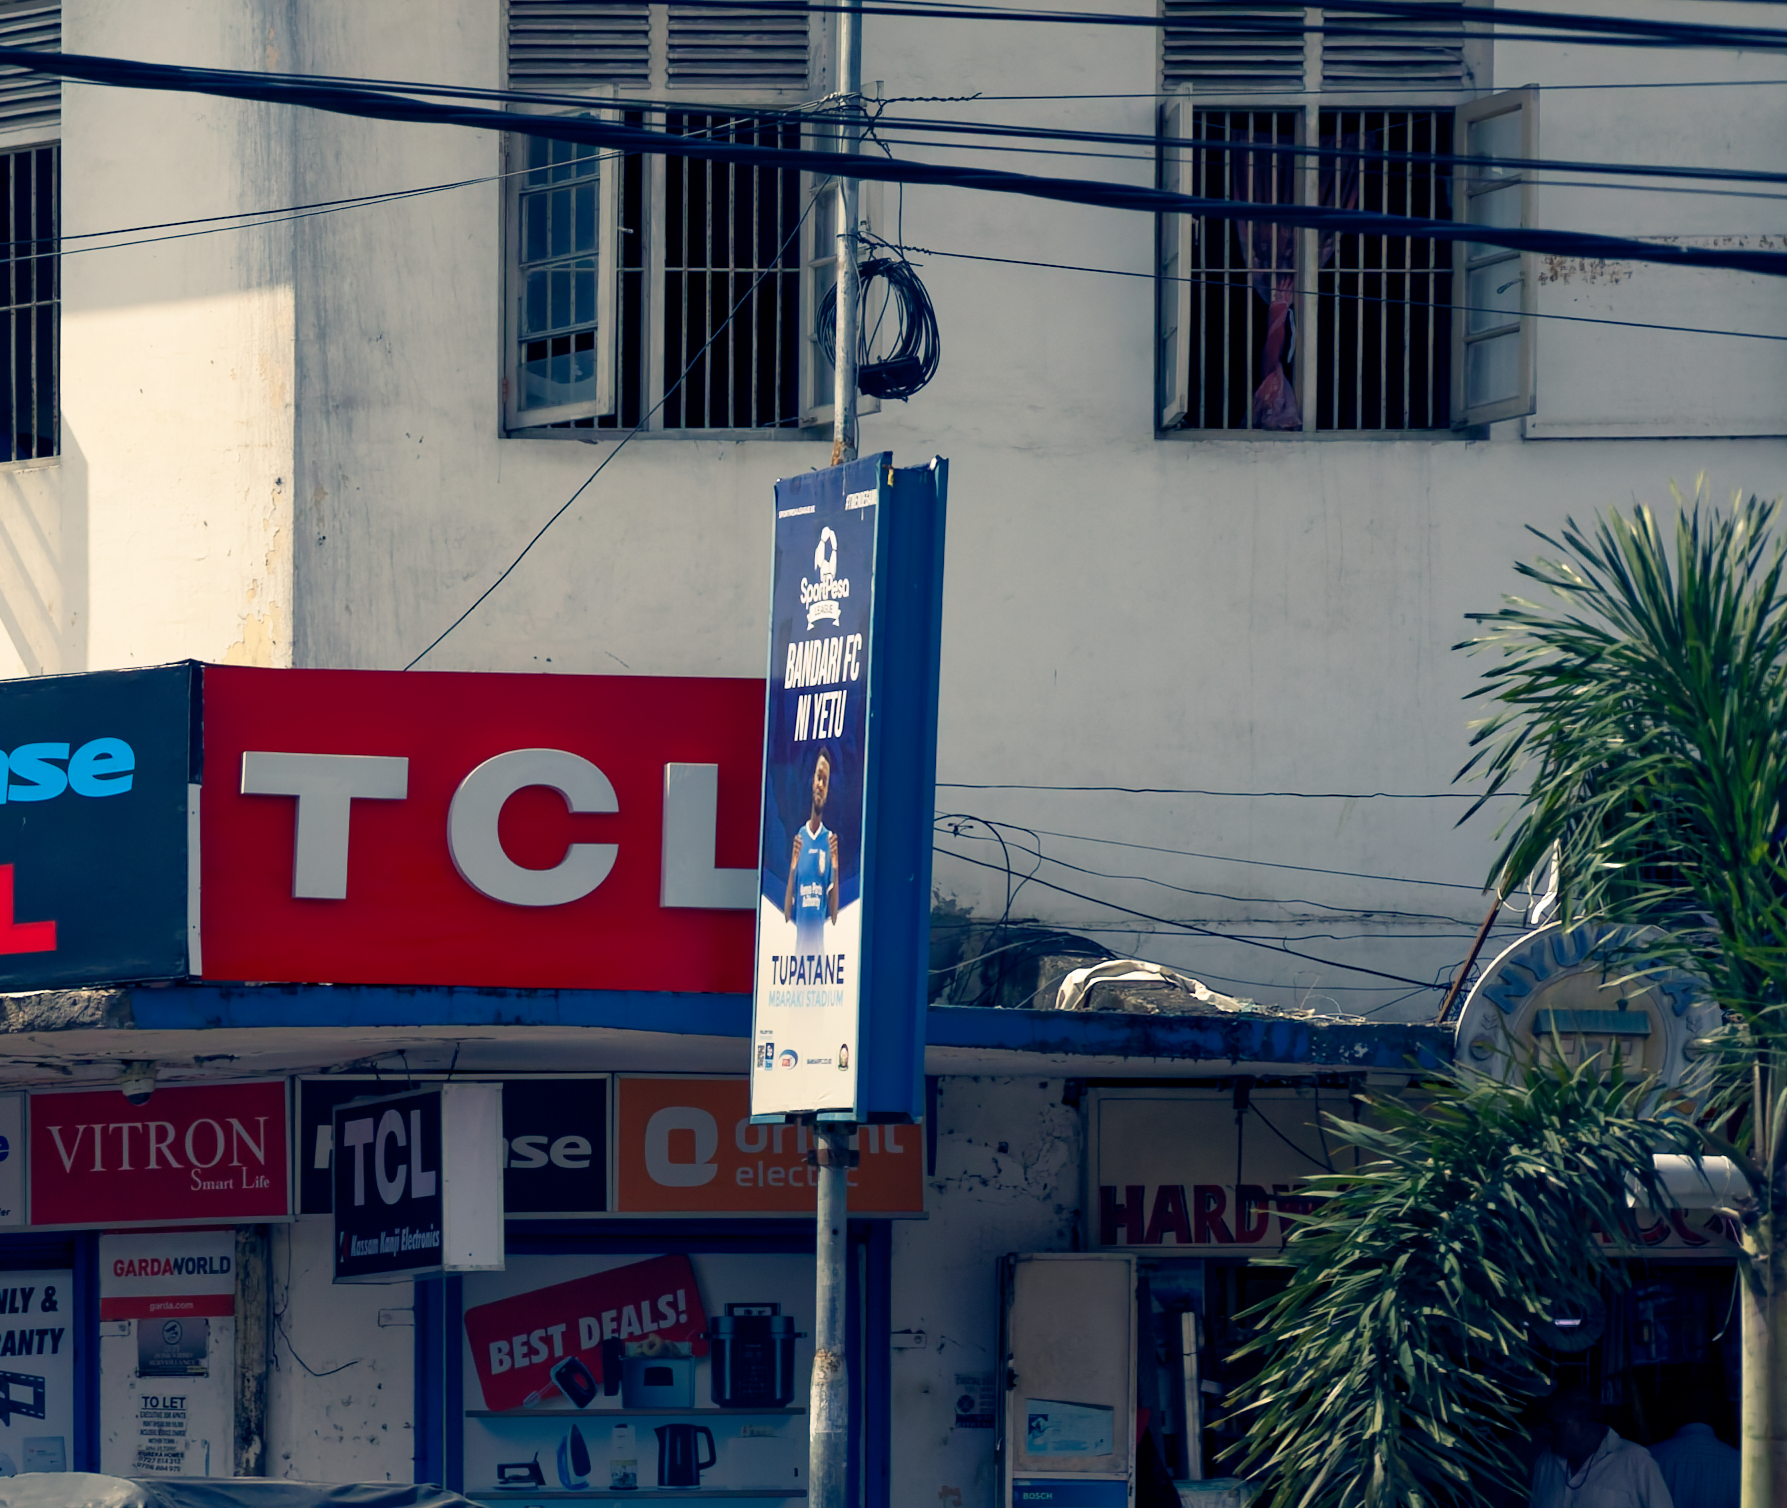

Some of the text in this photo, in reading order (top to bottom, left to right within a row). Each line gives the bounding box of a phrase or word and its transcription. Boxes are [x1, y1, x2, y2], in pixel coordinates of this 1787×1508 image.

[800, 572, 850, 609] SportPesa
[784, 632, 863, 690] BANDARI FC
[794, 690, 848, 742] NI YETU
[241, 747, 758, 911] TCL
[772, 953, 845, 986] TUPATANE
[768, 989, 844, 1007] MBARAKI STADIUM
[46, 1117, 270, 1173] VITRON
[735, 1118, 905, 1154] orint
[344, 1109, 436, 1206] TCL
[190, 1167, 270, 1191] Smart Life
[350, 1224, 440, 1258] Kassam Kanji Electronics
[113, 1256, 231, 1277] GARDAWORLD
[40, 1286, 58, 1311] &
[149, 1301, 194, 1312] garda.com
[489, 1289, 688, 1375] BEST DEALS!
[142, 1396, 186, 1409] TO LET
